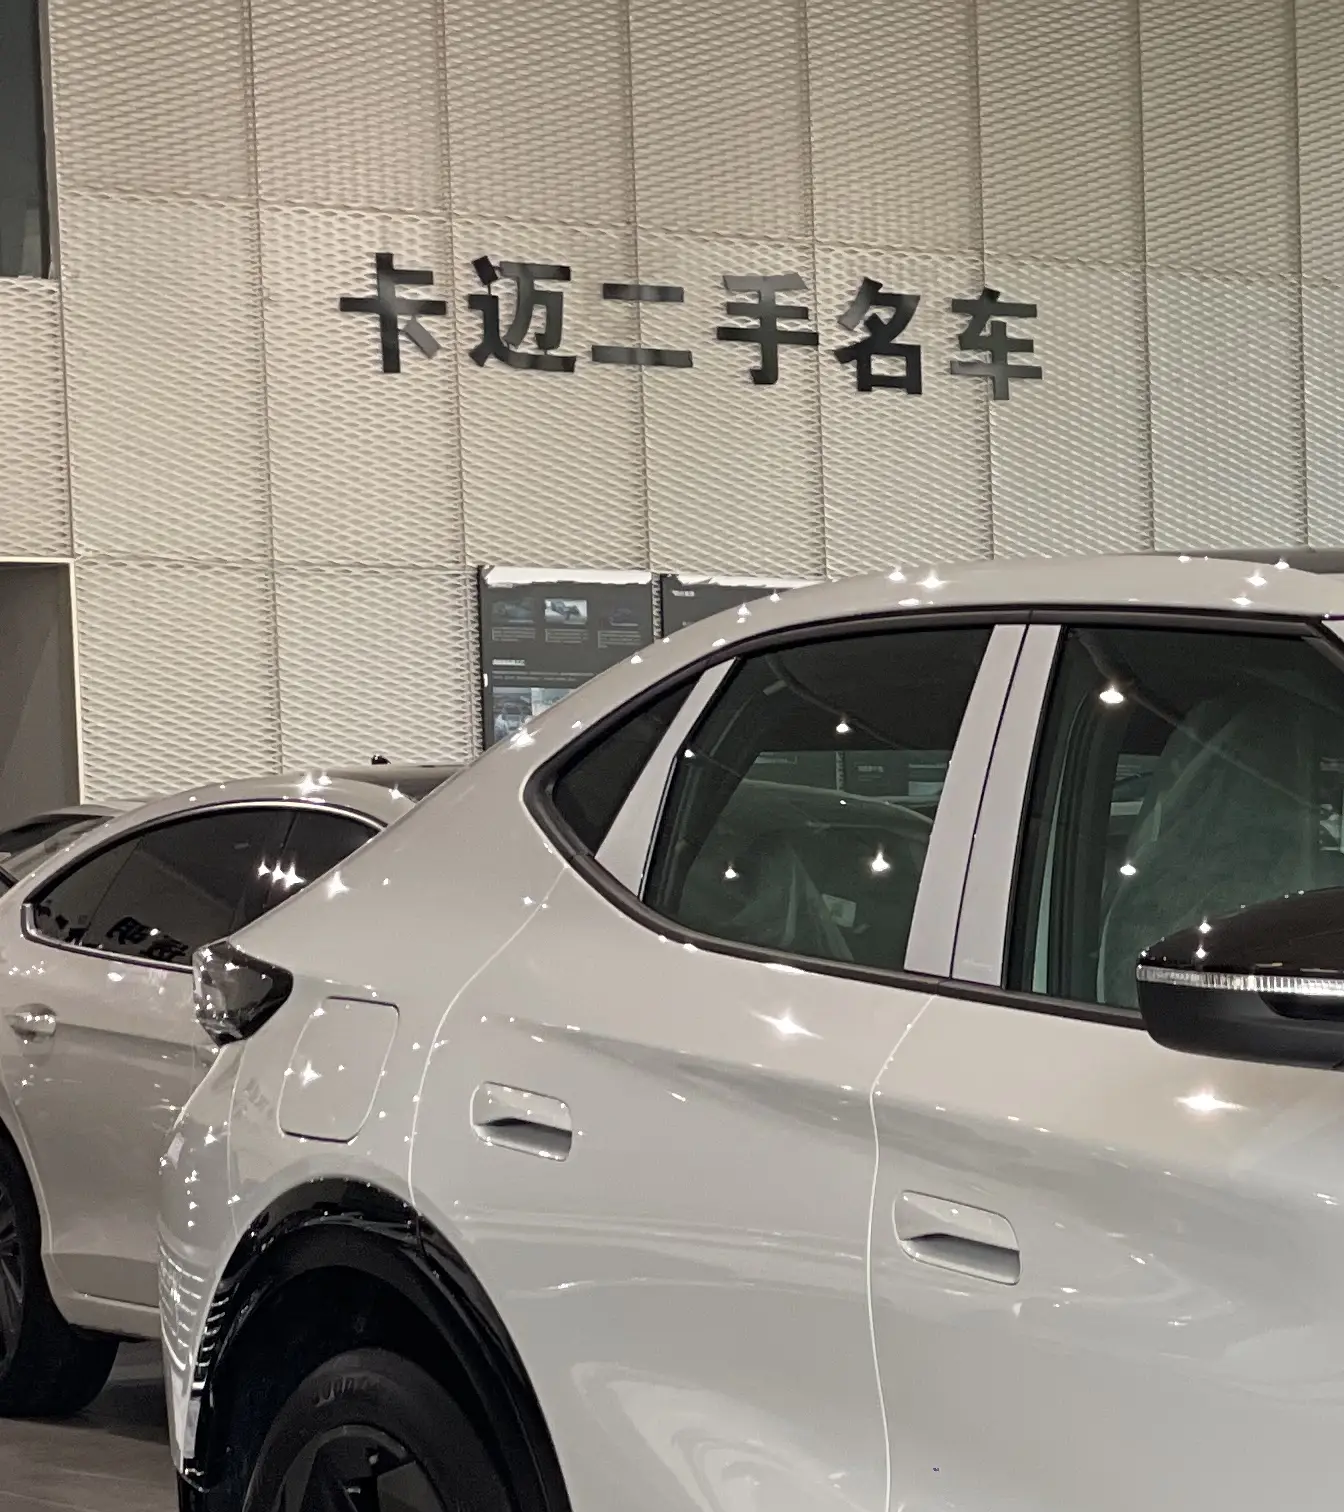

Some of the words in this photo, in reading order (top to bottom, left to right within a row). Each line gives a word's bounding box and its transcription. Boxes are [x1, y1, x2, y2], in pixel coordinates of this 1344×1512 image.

[339, 252, 1042, 400] 卡迈二手名车
